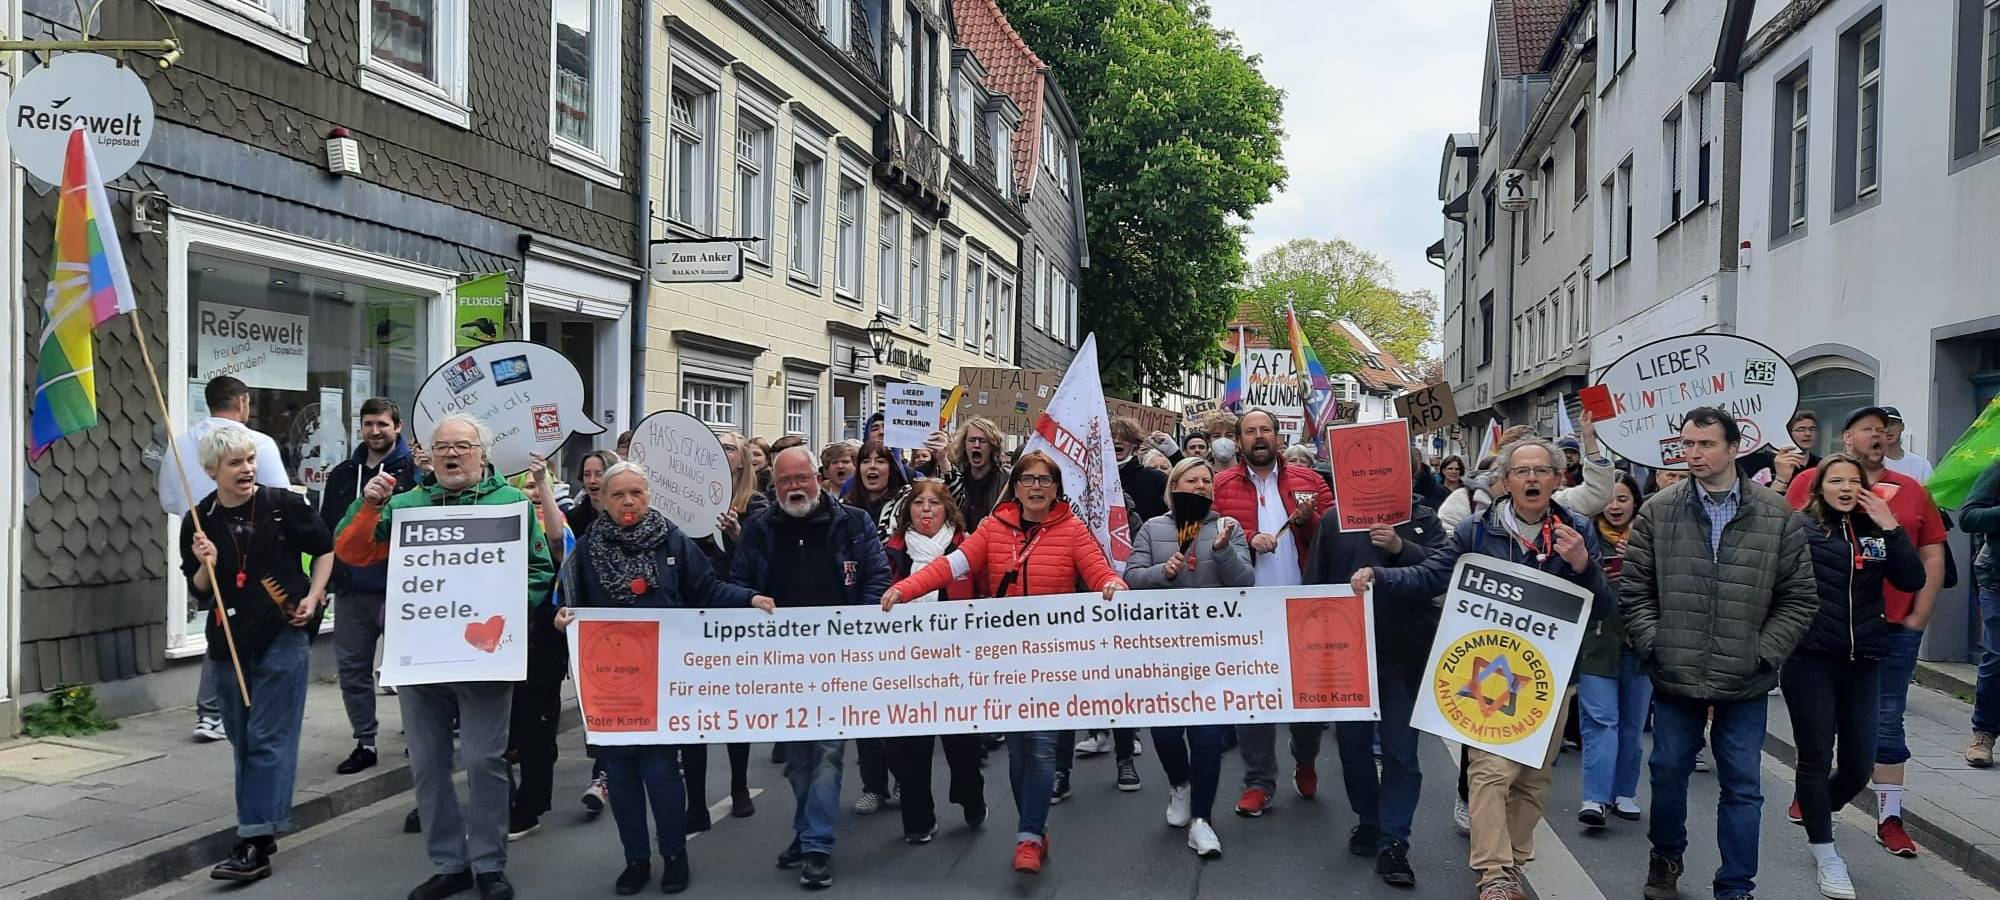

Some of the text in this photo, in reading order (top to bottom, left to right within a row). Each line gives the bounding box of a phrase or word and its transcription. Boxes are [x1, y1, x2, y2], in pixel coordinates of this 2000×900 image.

[97, 136, 140, 147] Lippstadt
[671, 252, 733, 263] Zum Anker
[459, 296, 503, 307] FLIXBUS
[201, 310, 304, 346] Reisewelt
[213, 340, 252, 361] frei und
[269, 344, 305, 357] Lippstadt
[1636, 344, 1711, 381] LIEBER
[1746, 360, 1776, 372] FCK
[963, 369, 1042, 391] VIELFALT
[1745, 371, 1775, 382] AFD
[503, 390, 531, 411] als
[1407, 388, 1439, 414] FCK
[1613, 370, 1737, 415] KUNTERBUNT
[1280, 420, 1298, 431] TEI
[1411, 404, 1444, 430] AFD
[1620, 393, 1763, 438] STATT KAAUN
[649, 420, 679, 455] HASS
[1054, 427, 1089, 470] VIEL
[1351, 466, 1393, 477] Ich zeige
[1346, 511, 1405, 525] Rote Karte
[404, 524, 465, 543] Hass
[403, 547, 506, 567] schadet
[402, 575, 446, 594] der
[1464, 569, 1525, 602] Hass
[400, 600, 479, 620] Seele.
[1456, 598, 1559, 641] schadet
[703, 600, 1242, 642] Lippstädter Netzwerk für Frieden und Solidarität e.V.
[683, 652, 731, 669] Gegen
[736, 651, 758, 666] ein
[763, 650, 805, 665] Klima
[809, 652, 836, 664] von
[841, 648, 874, 663] Hass
[879, 646, 906, 661] und
[910, 644, 961, 660] Gewalt
[975, 643, 1017, 660] gegen
[1022, 638, 1096, 657] Rassismus
[1099, 639, 1109, 649] +
[1113, 630, 1264, 650] Rechtsextremismus!
[613, 664, 640, 675] zeige
[669, 660, 1280, 696] Für eine tolerante + offene Gesellschaft, für freie Presse und unabhängige Gerichte
[1442, 634, 1549, 702] ZUSAMMEN GEGEN
[1299, 691, 1365, 704] Rote Karte
[668, 714, 690, 732] es
[697, 709, 721, 731] ist
[727, 710, 739, 729] 5
[745, 714, 779, 729] vor
[785, 707, 809, 729] 12
[816, 706, 821, 727] !
[842, 705, 881, 726] Ihre
[887, 701, 938, 724] Wahl
[944, 704, 978, 722] nur
[983, 698, 1013, 720] für
[1018, 697, 1060, 718] eine
[1066, 690, 1216, 717] demokratische
[1223, 688, 1284, 711] Partei
[1437, 678, 1544, 739] ANTISEMITISMUS
[586, 714, 651, 727] Rote Karte
